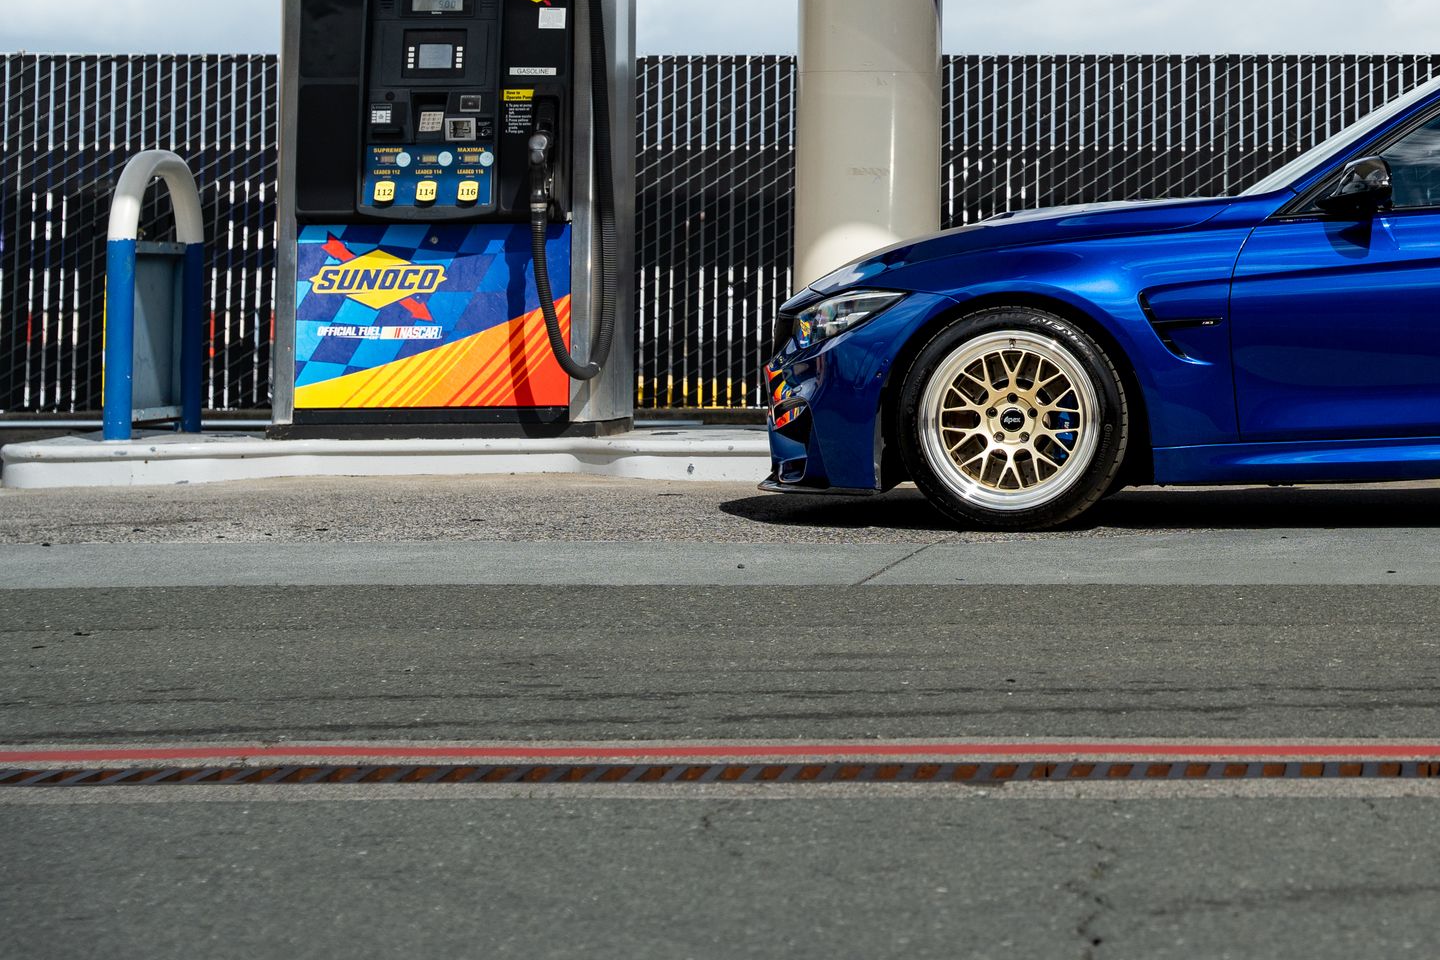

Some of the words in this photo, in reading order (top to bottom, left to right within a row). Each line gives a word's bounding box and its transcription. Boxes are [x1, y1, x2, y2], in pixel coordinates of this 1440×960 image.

[318, 269, 440, 290] SUNOCO
[317, 326, 357, 337] OFFICIAL
[358, 326, 380, 337] FUEL
[399, 326, 440, 339] NASCAR
[1003, 416, 1021, 424] Apex
